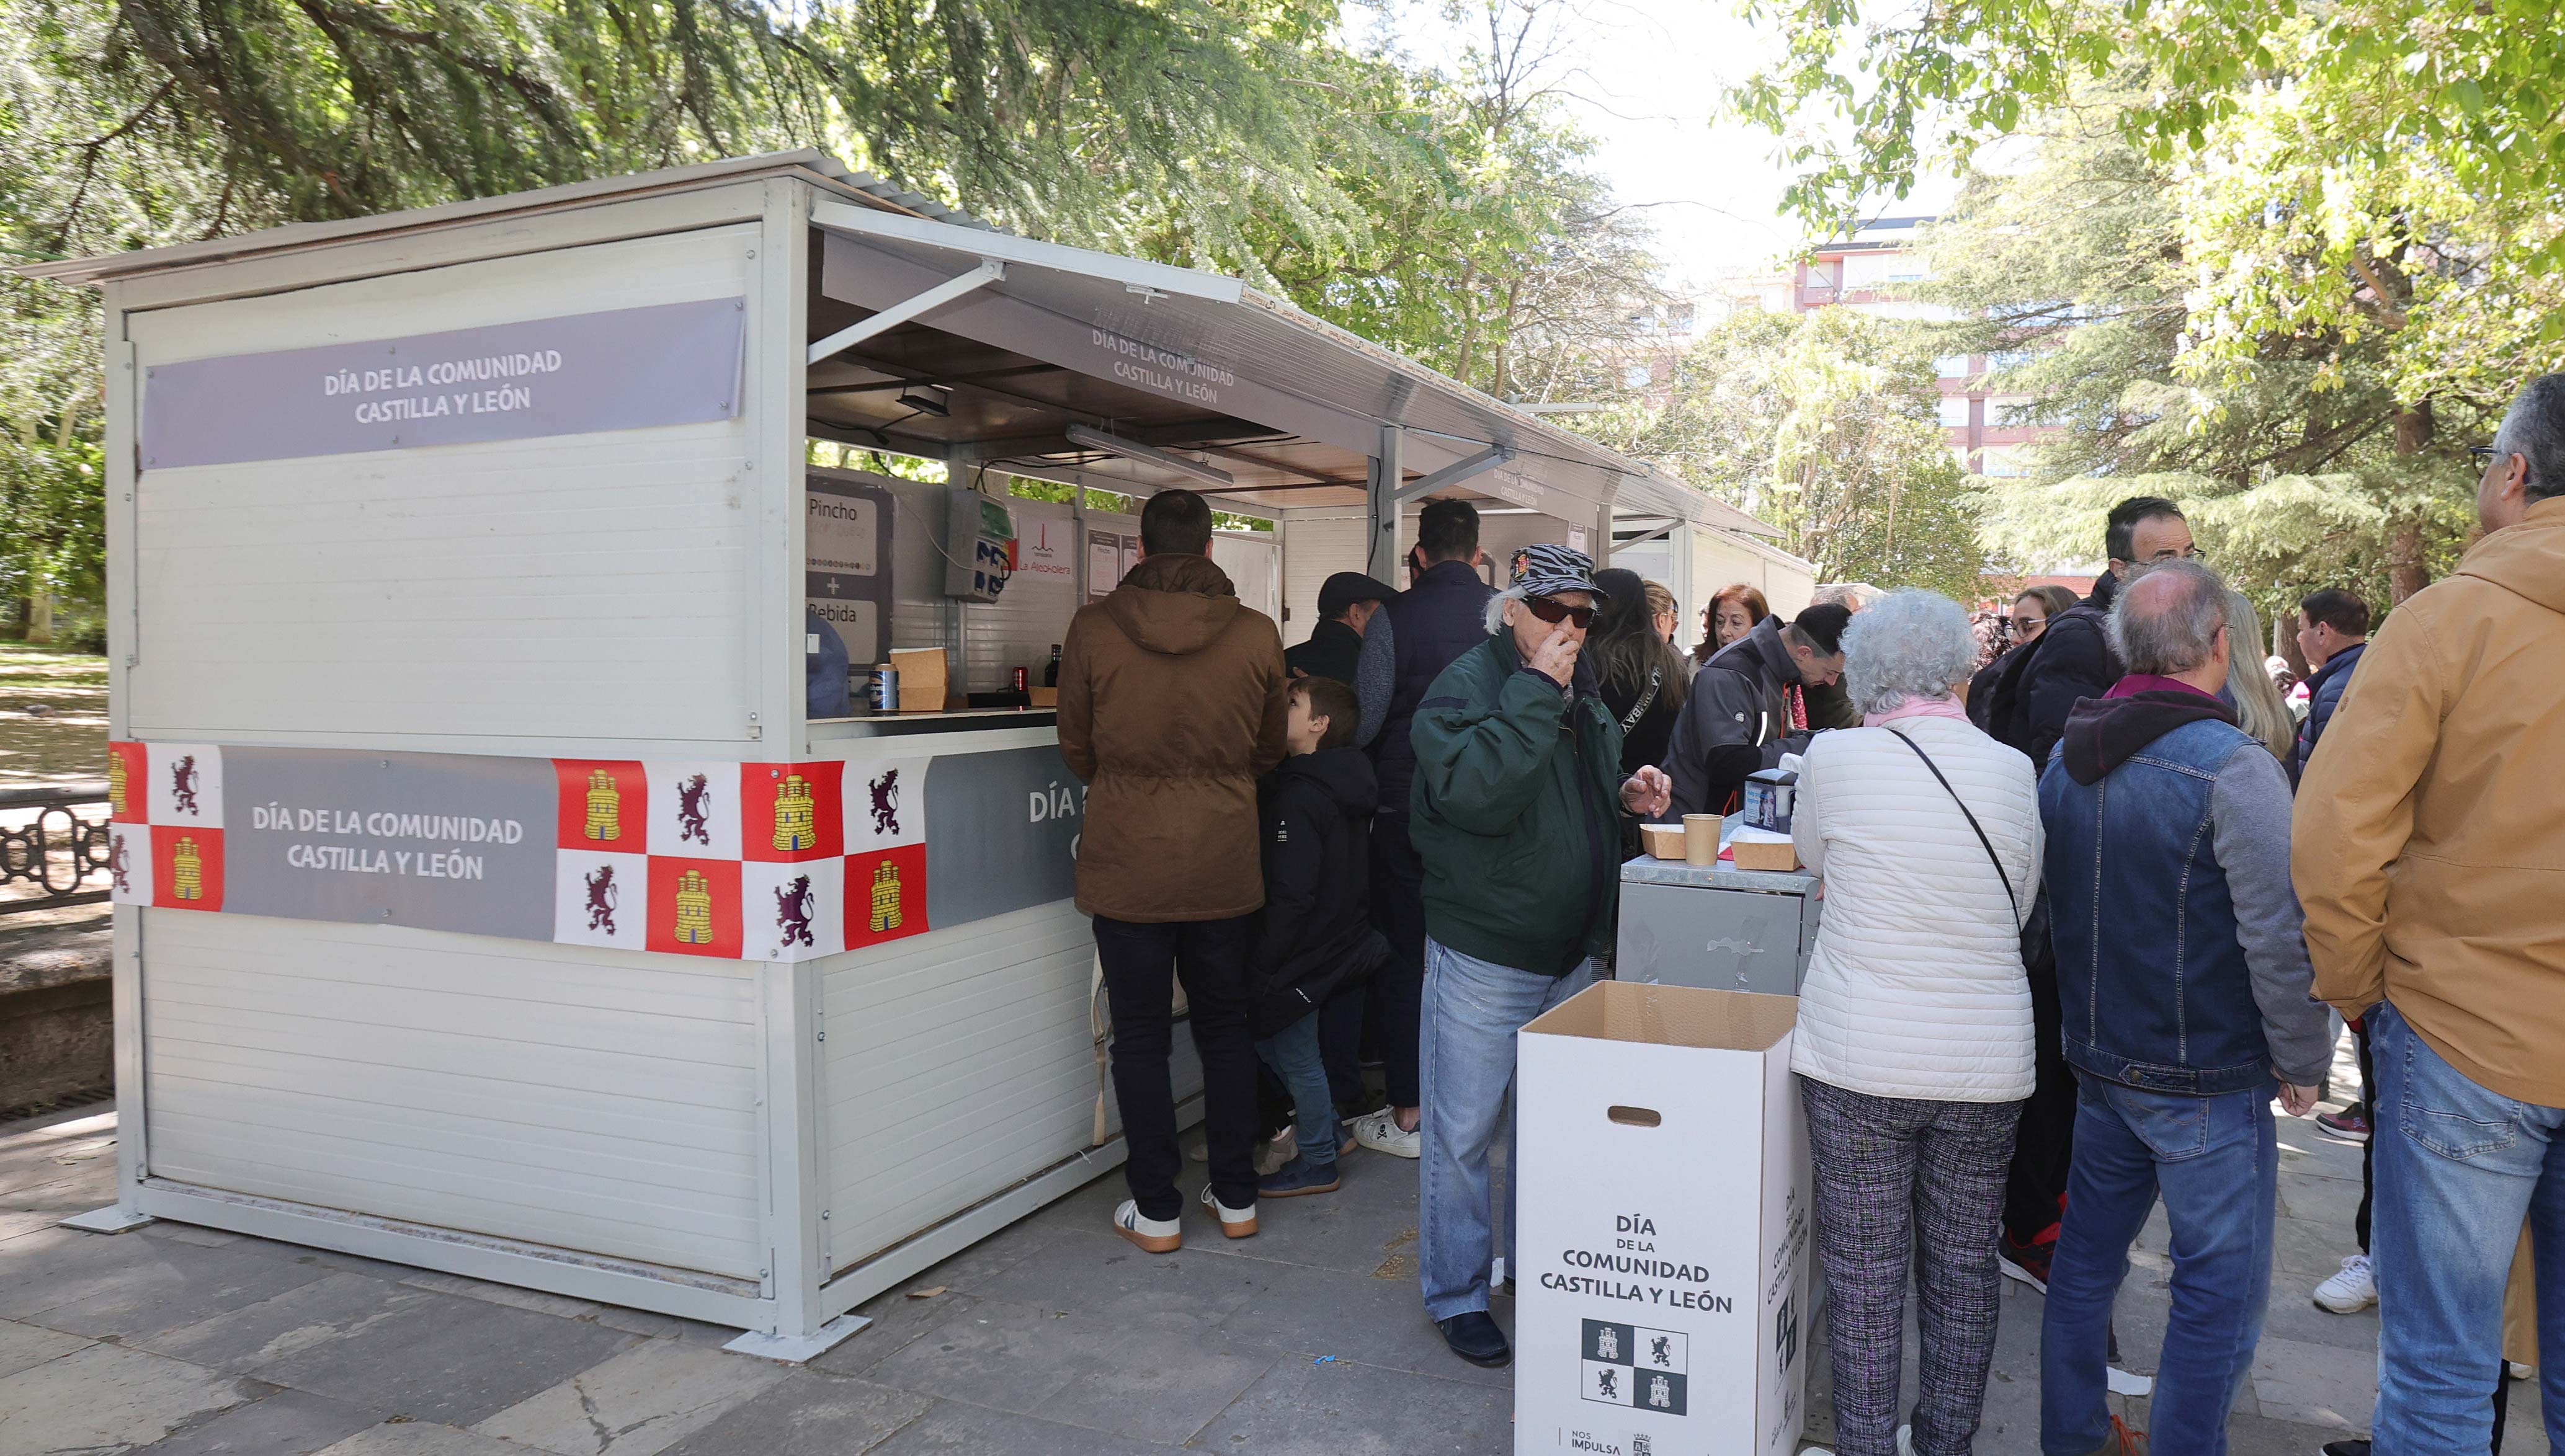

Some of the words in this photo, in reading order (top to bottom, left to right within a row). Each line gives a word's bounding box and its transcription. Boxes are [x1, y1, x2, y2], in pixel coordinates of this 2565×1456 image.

[1092, 328, 1117, 351] DÍA
[1120, 339, 1137, 358] DE
[1141, 345, 1156, 364] LA
[324, 368, 360, 396] DÍA
[365, 369, 392, 392] DE
[396, 366, 423, 388] LA
[427, 349, 562, 385] COMUNIDAD
[1114, 361, 1173, 391] CASTILLA
[1175, 379, 1184, 394] Y
[1185, 383, 1217, 404] LEÓN
[355, 395, 450, 424] CASTILLA
[453, 393, 468, 414] Y
[472, 383, 531, 413] LEÓN
[810, 498, 857, 521] Pincho
[1030, 780, 1076, 823] DÍA
[252, 801, 295, 831] DÍA
[298, 808, 329, 832] DE
[334, 810, 363, 835] LA
[367, 812, 523, 845] COMUNIDAD
[287, 844, 391, 874] CASTILLA
[395, 851, 412, 875] Y
[416, 848, 483, 880] LEÓN
[1616, 1213, 1657, 1236] DÍA
[1616, 1238, 1635, 1250] DE
[1638, 1241, 1655, 1253] LA
[1563, 1250, 1710, 1283] COMUNIDAD
[1540, 1272, 1644, 1302] CASTILLA
[1649, 1287, 1664, 1304] Y
[1669, 1290, 1733, 1313] LEÓN
[1572, 1430, 1592, 1440] NOS
